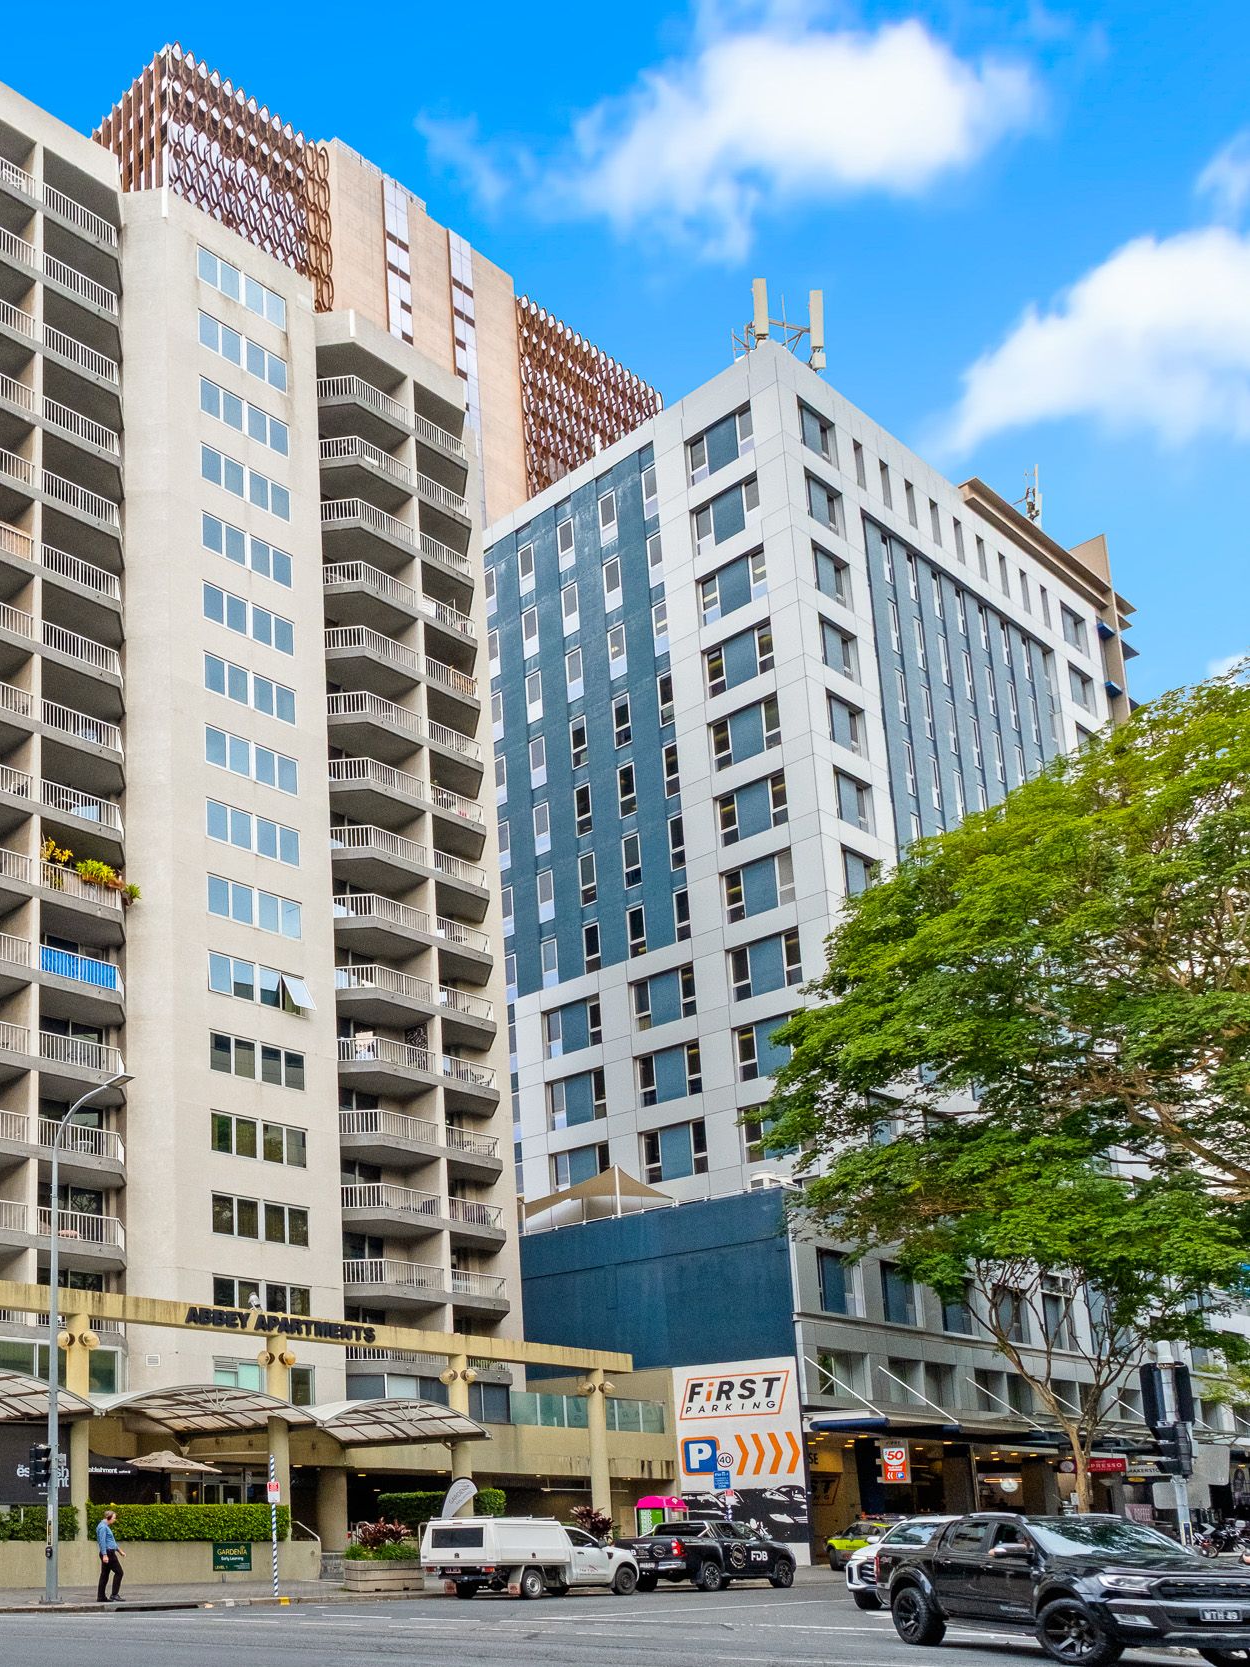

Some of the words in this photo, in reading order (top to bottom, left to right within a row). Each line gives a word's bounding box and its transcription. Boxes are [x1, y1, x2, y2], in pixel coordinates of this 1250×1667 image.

[184, 1306, 250, 1329] ABBEY
[253, 1314, 376, 1343] APARTMENTS
[686, 1400, 776, 1414] PARKING
[688, 1442, 713, 1469] P
[719, 1456, 731, 1464] 40
[216, 1548, 248, 1556] GARDENIA
[751, 1550, 768, 1561] FDB
